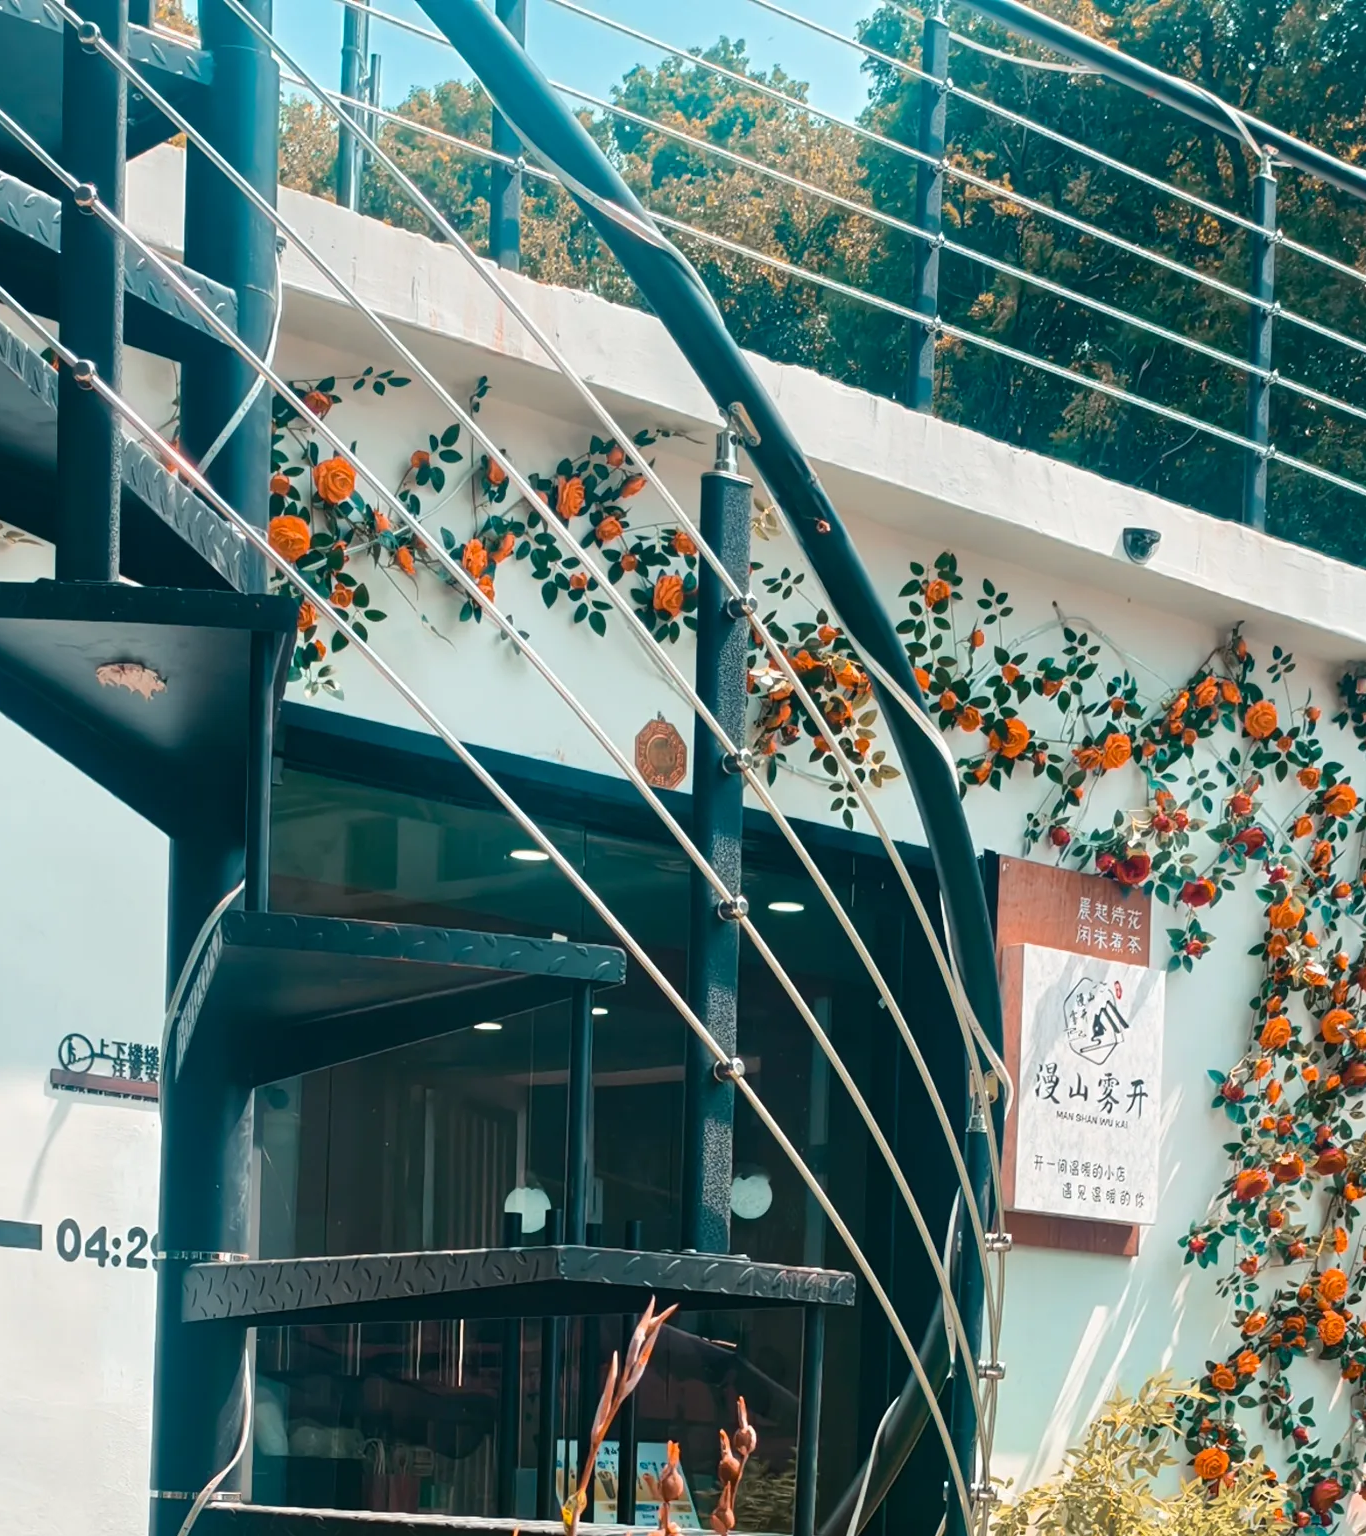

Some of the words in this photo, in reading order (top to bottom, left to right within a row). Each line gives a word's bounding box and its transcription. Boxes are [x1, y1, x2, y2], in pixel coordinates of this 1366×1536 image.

[1034, 1062, 1149, 1120] 漫山雾开
[1055, 1110, 1074, 1122] MAN
[1076, 1113, 1098, 1126] SHAN
[1100, 1117, 1114, 1128] WU
